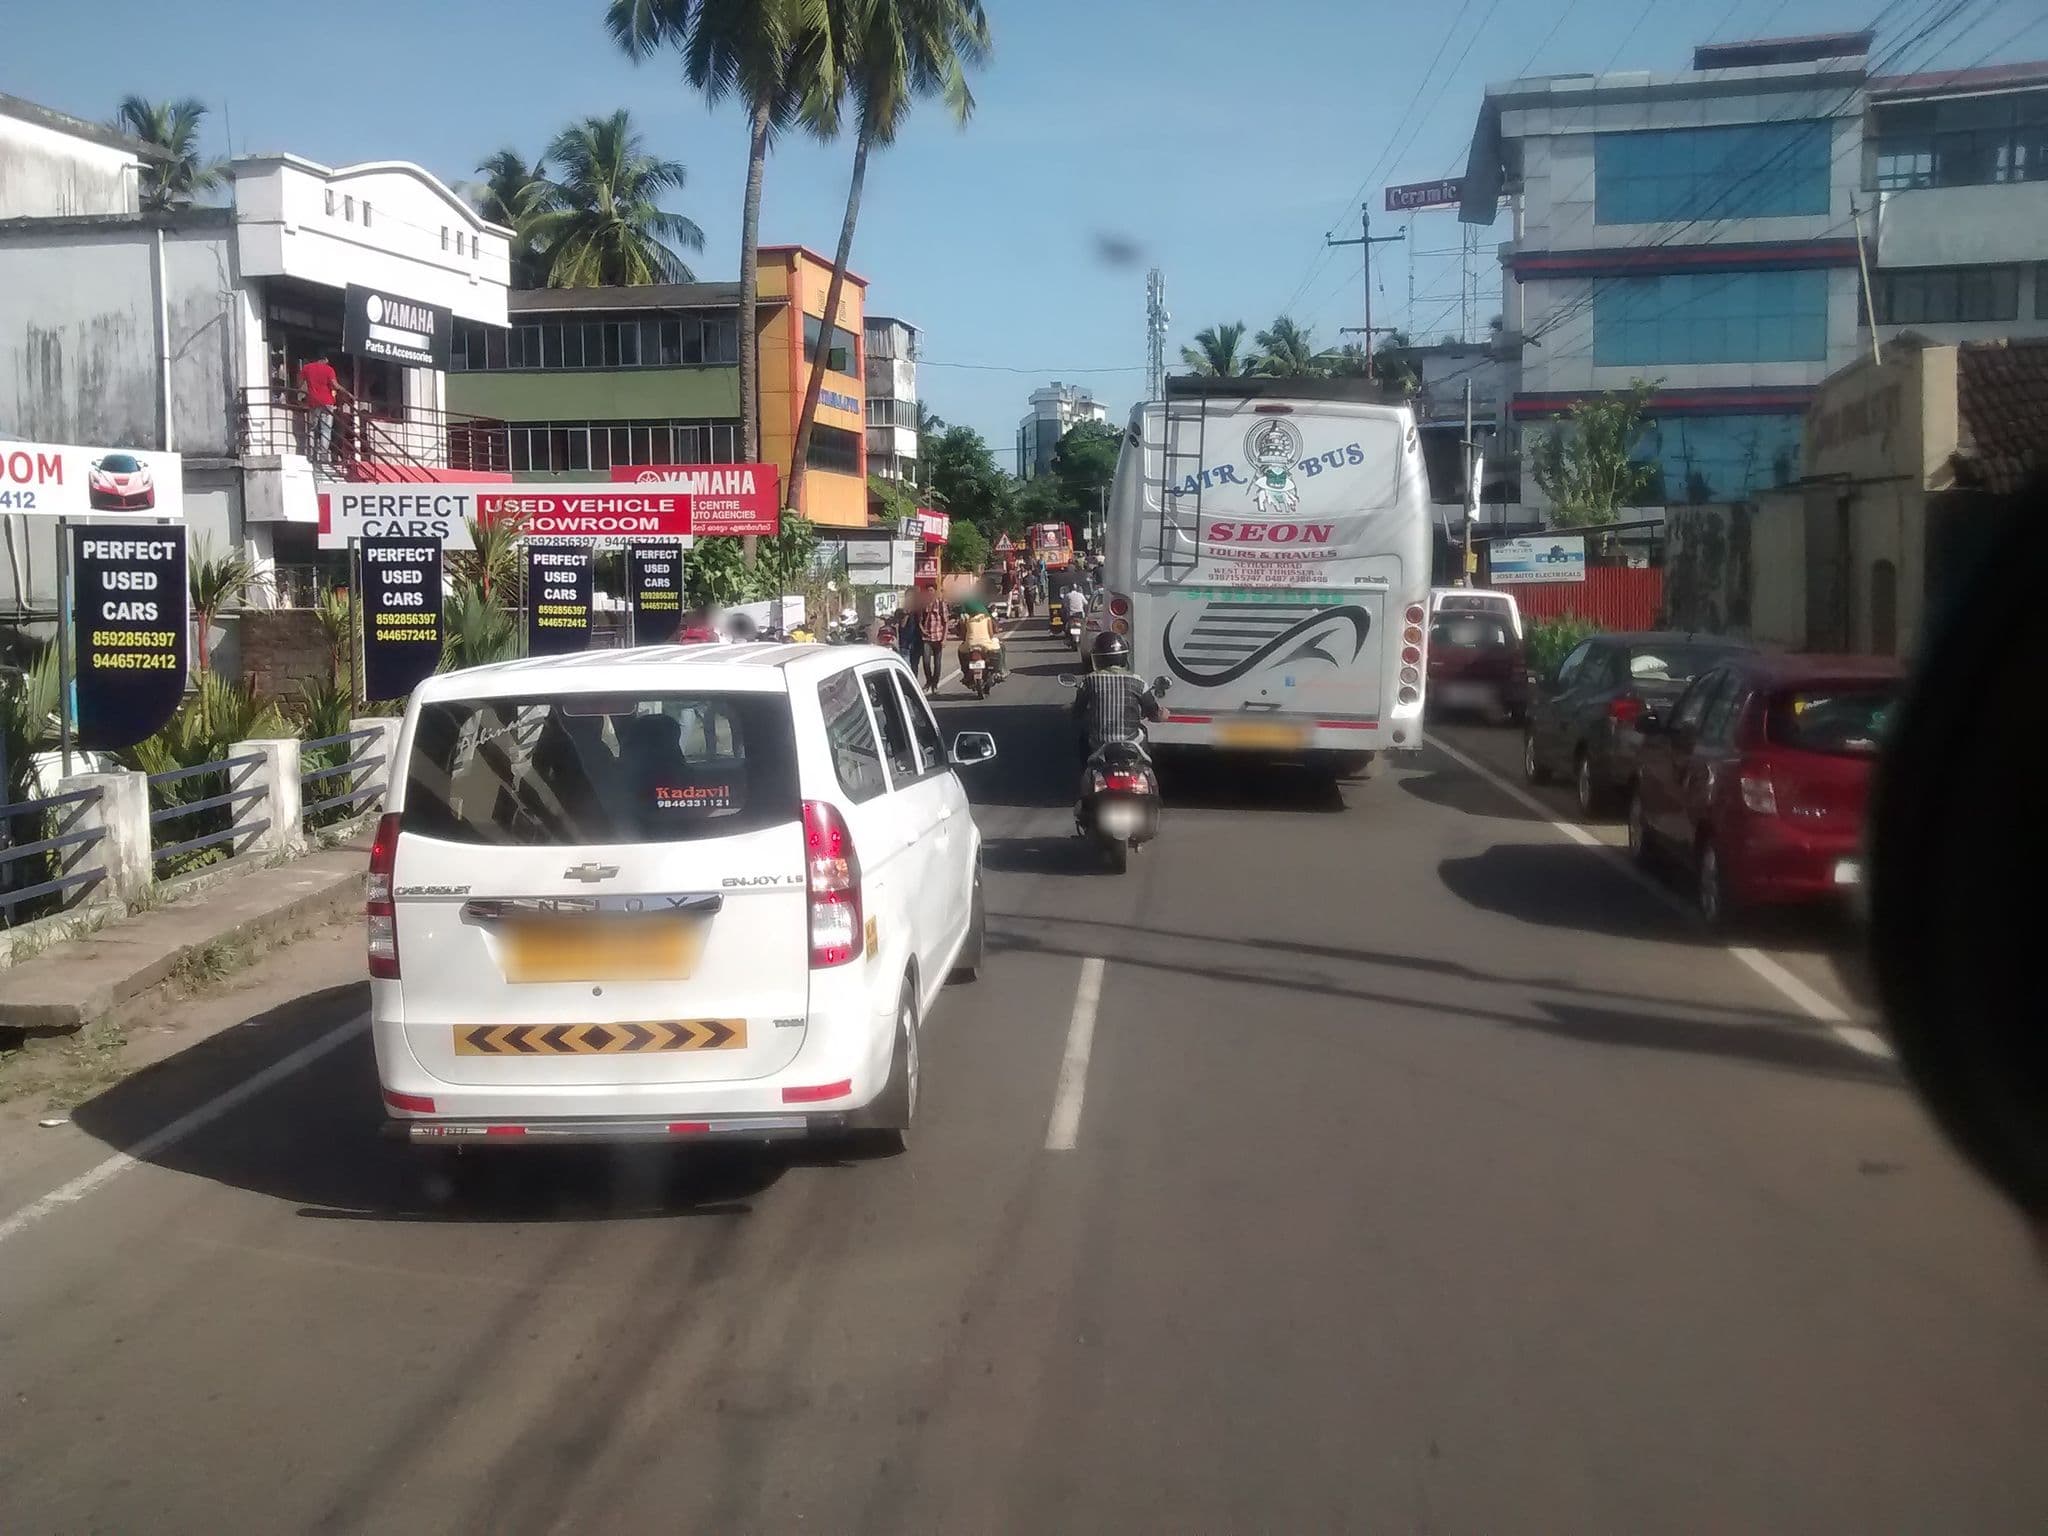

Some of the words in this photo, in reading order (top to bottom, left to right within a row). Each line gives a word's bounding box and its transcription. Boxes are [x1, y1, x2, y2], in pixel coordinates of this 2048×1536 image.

[1389, 182, 1457, 206] Ceramic
[383, 299, 435, 335] YAMAHA
[365, 339, 385, 354] Parts
[385, 344, 391, 355] &
[391, 346, 433, 364] Accessories
[0, 451, 63, 485] OM
[1173, 463, 1248, 497] AIR
[1298, 443, 1365, 478] BUS
[342, 495, 469, 517] PERFECT
[485, 499, 556, 513] USED
[562, 499, 675, 512] VEHICLE
[698, 500, 740, 510] CENTRE
[692, 511, 711, 519] UTO
[712, 511, 756, 519] AGENCIES
[362, 520, 450, 539] CARS
[1207, 523, 1336, 543] SEON
[83, 541, 176, 560] PERFECT
[367, 548, 435, 562] PERFECT
[635, 550, 678, 560] PERFECT
[1208, 547, 1256, 558] TOURS
[1260, 551, 1269, 559] &
[1271, 550, 1337, 560] TRAVELS
[533, 554, 588, 566] PERFECT
[644, 564, 670, 574] USED
[102, 572, 158, 590] USED
[381, 570, 423, 584] USED
[544, 571, 577, 583] USED
[644, 577, 670, 588] CARS
[382, 592, 424, 606] CARS
[544, 588, 577, 601] CARS
[877, 594, 896, 610] BJP
[102, 602, 158, 621] CARS
[538, 604, 587, 615] 8592856397
[376, 613, 437, 625] 8592856397
[538, 617, 587, 628] 9446572412
[92, 632, 176, 647] 8592856397
[376, 629, 437, 641] 9446572412
[93, 654, 176, 669] 9446572412
[655, 785, 730, 799] Kadavil
[657, 799, 730, 808] 9846331121
[722, 875, 782, 887] ENJOY
